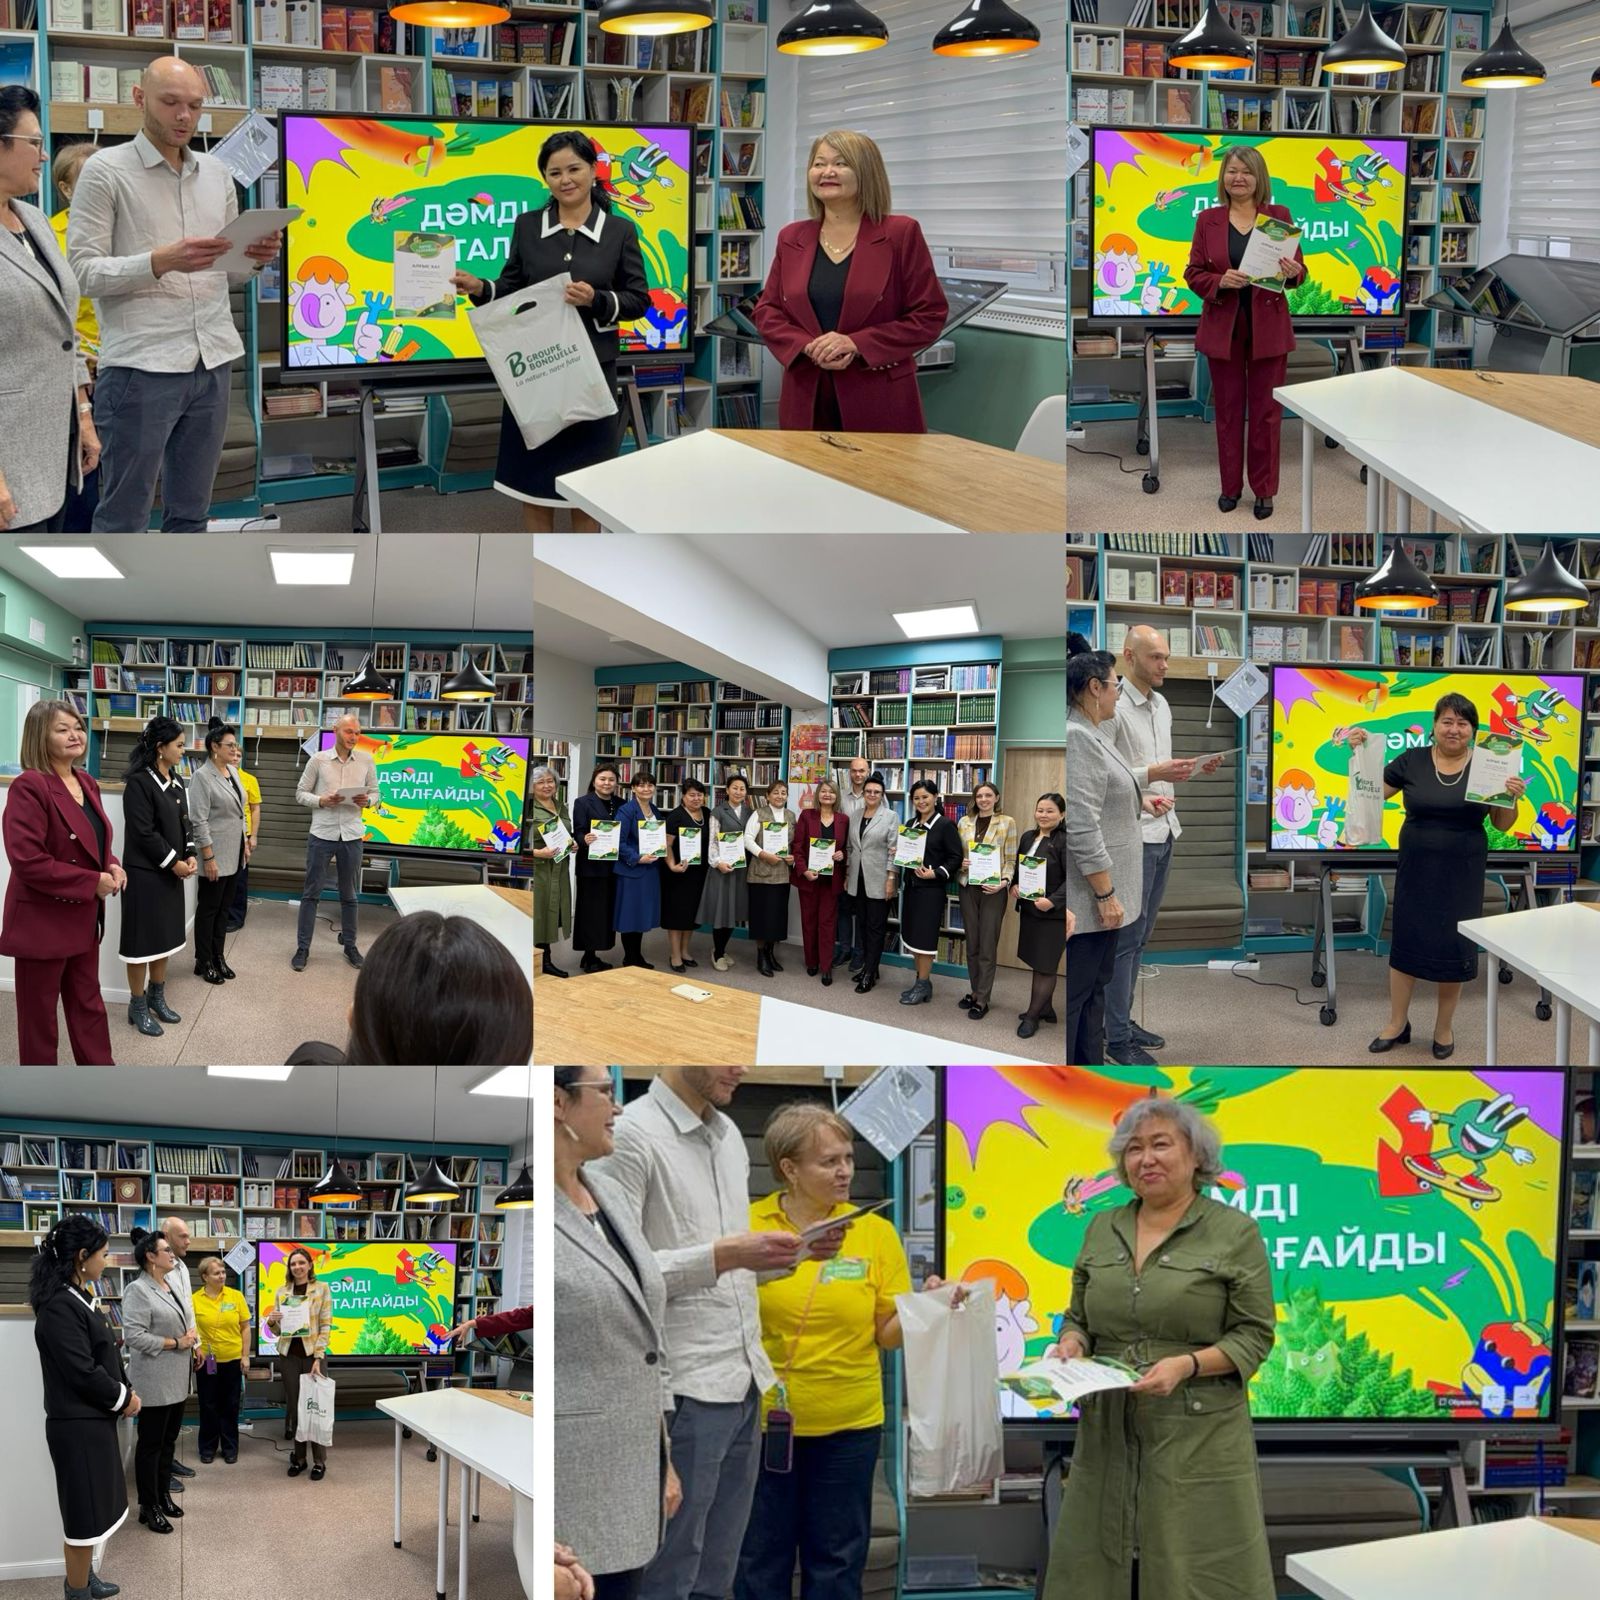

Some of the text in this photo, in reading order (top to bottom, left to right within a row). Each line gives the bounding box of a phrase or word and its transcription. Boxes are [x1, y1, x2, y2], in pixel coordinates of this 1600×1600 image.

[526, 343, 562, 363] GROUPE
[529, 344, 579, 371] BONDUELLE
[525, 371, 549, 383] nature,
[549, 364, 565, 374] notre
[378, 771, 433, 784] ДӘМДІ
[391, 786, 485, 802] ТАЛҒАЙДЫ
[1209, 1183, 1299, 1223] МДІ
[1263, 1225, 1446, 1273] ҒАЙДЫ
[330, 1280, 371, 1293] ӘМДІ
[332, 1293, 419, 1309] ТАЛҒАЙДЫ
